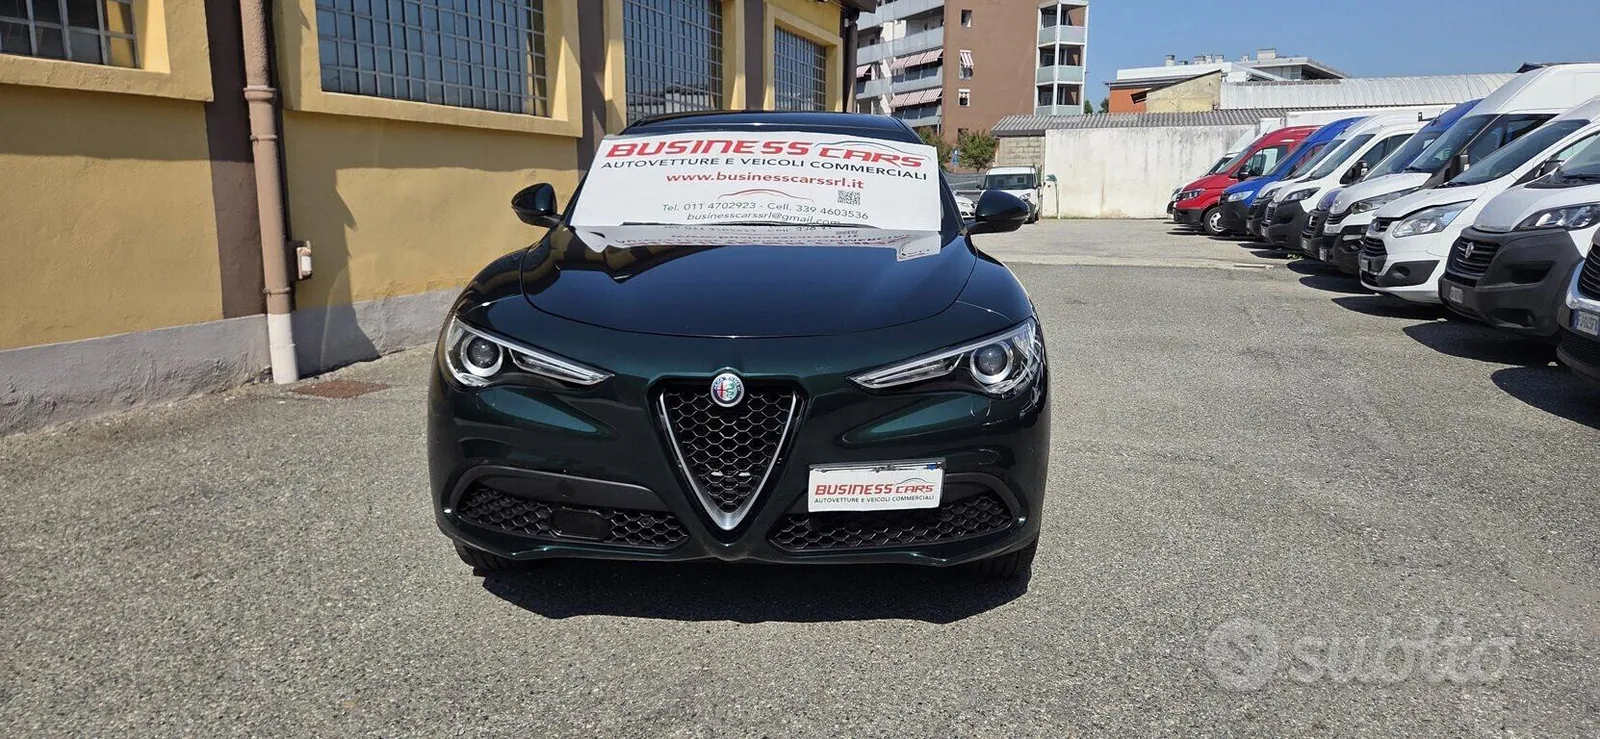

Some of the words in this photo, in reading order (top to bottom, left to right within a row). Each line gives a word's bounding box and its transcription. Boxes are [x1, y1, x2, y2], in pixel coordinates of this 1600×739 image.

[605, 140, 814, 158] BUSINESS
[818, 147, 926, 168] CARS
[601, 158, 720, 169] AUTOVETTURE
[725, 157, 734, 165] E
[740, 158, 804, 167] VEICOLI
[809, 161, 927, 181] COMMERCIALI
[666, 172, 865, 189] www.businesscarssrl.it
[662, 204, 680, 212] Tel.
[683, 203, 703, 211] 011
[707, 202, 756, 210] 4702923
[767, 202, 792, 211] Cell.
[796, 204, 817, 214] 339
[820, 207, 869, 220] 4603536
[686, 211, 841, 225] businesscarssrl@gmail.com
[815, 483, 894, 496] BUSINESS
[895, 484, 935, 494] CARS
